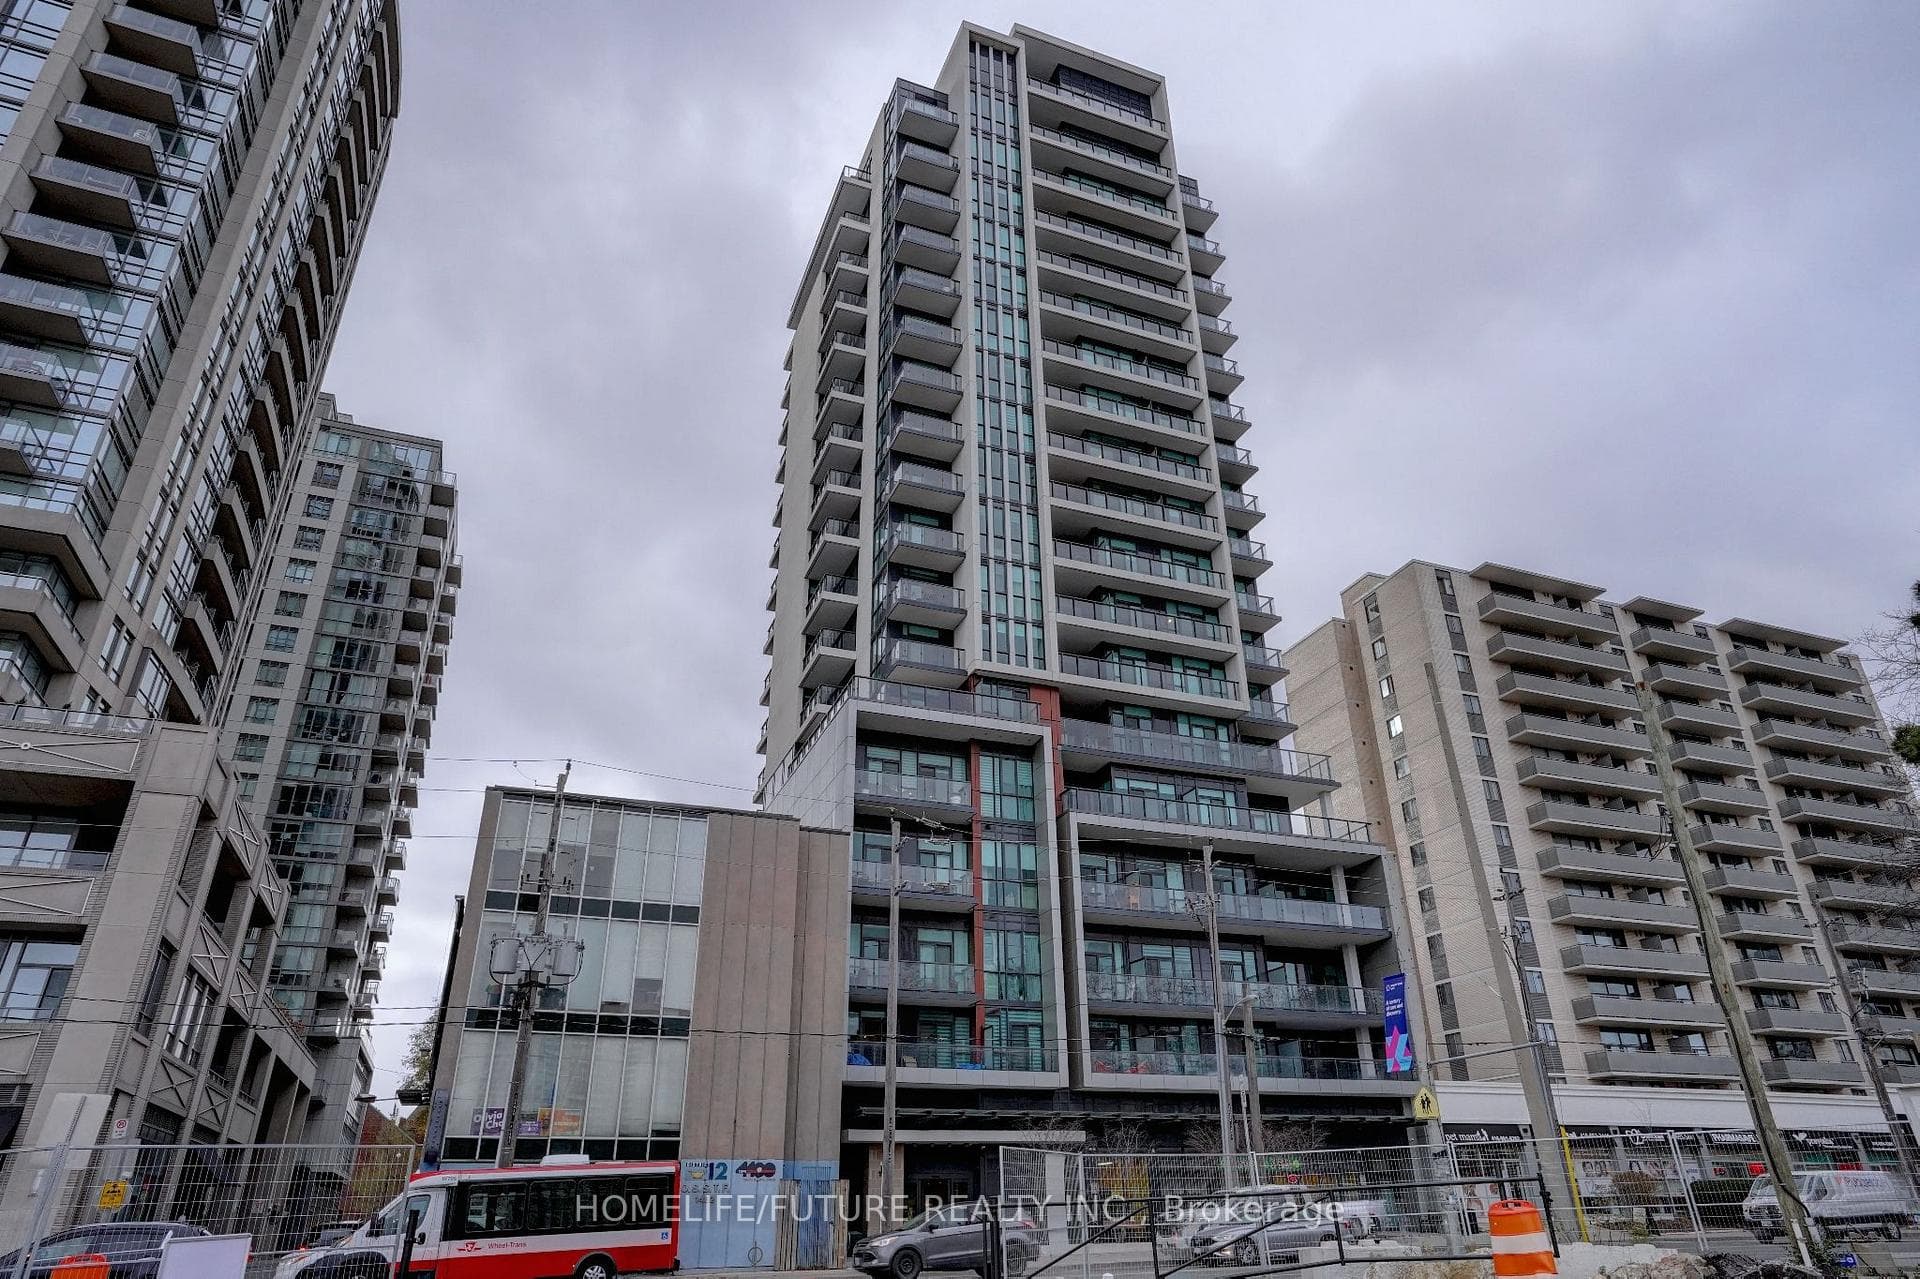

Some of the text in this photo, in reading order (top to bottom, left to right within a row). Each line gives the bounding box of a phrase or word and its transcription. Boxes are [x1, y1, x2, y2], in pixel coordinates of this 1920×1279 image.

[473, 1110, 503, 1123] Oivia
[485, 1119, 504, 1130] Cho
[708, 1162, 728, 1180] 12
[488, 1241, 528, 1249] Wheel-Trans
